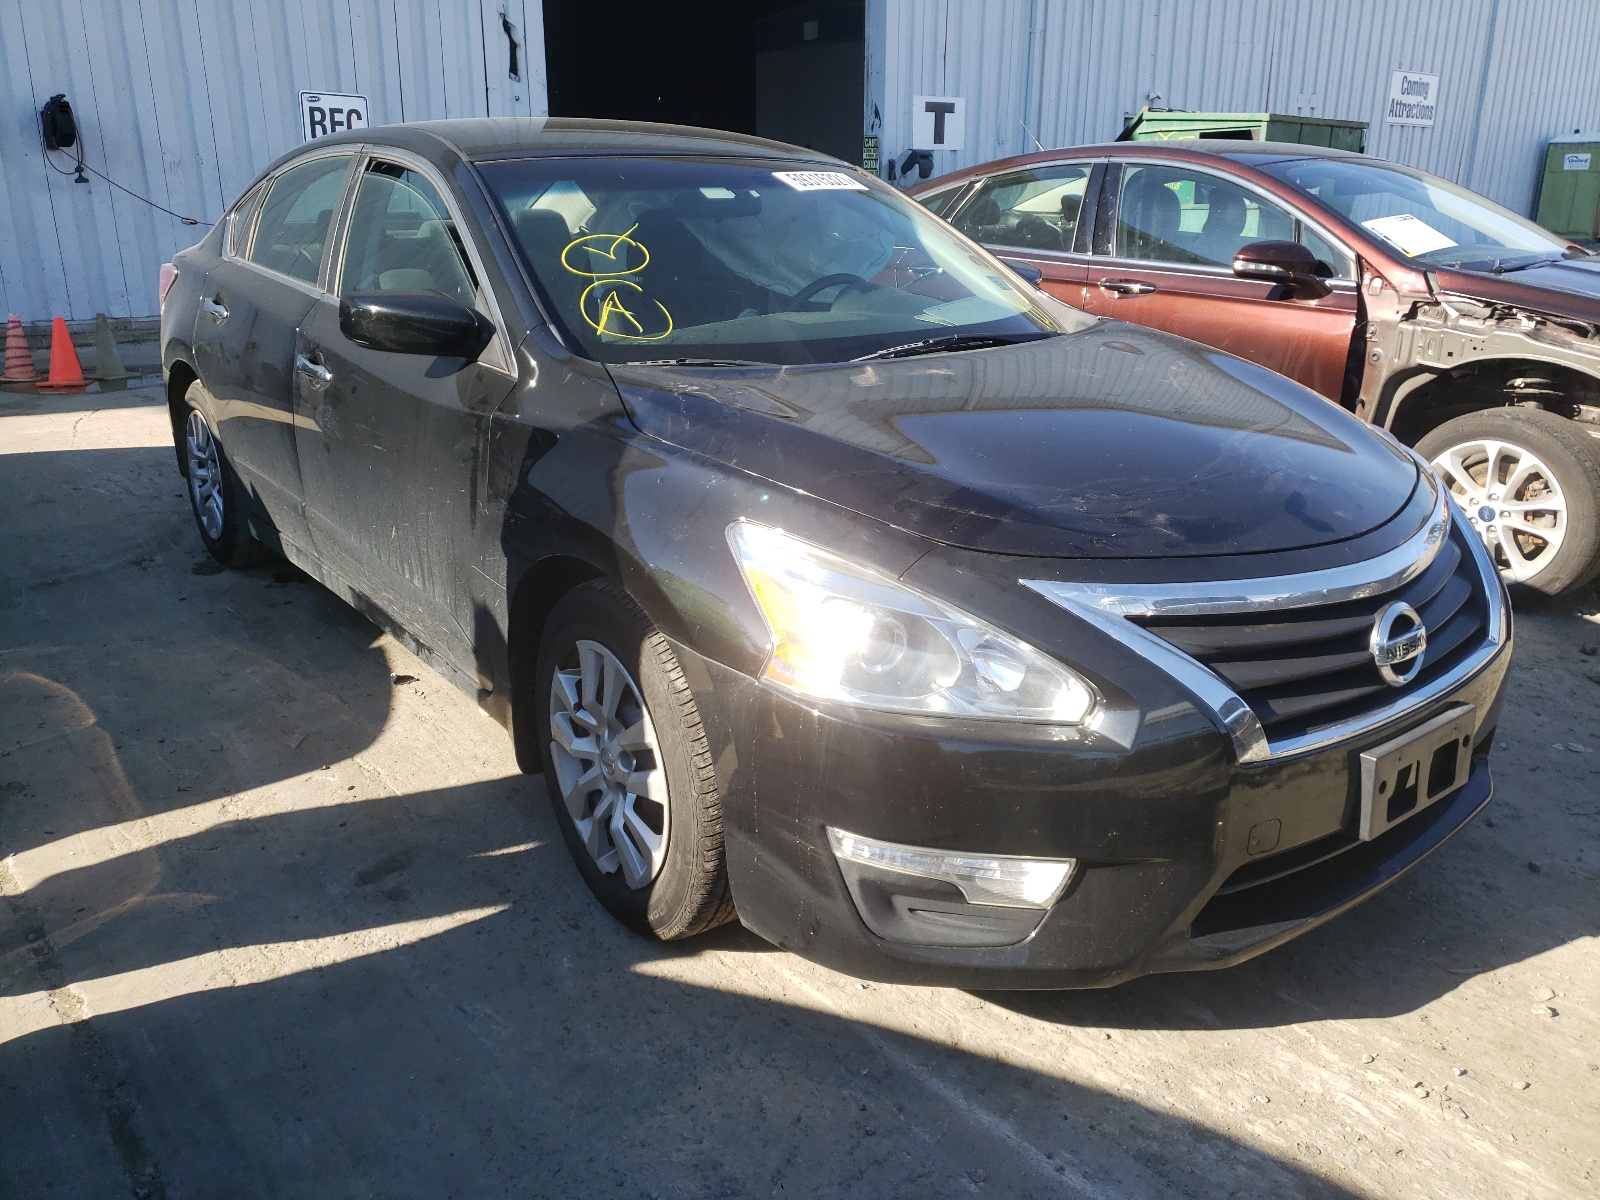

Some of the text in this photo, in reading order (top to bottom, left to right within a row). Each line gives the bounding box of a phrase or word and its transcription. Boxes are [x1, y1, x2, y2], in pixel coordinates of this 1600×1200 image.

[1401, 75, 1430, 100] Coming
[1388, 98, 1434, 121] Attractions
[925, 101, 955, 145] T
